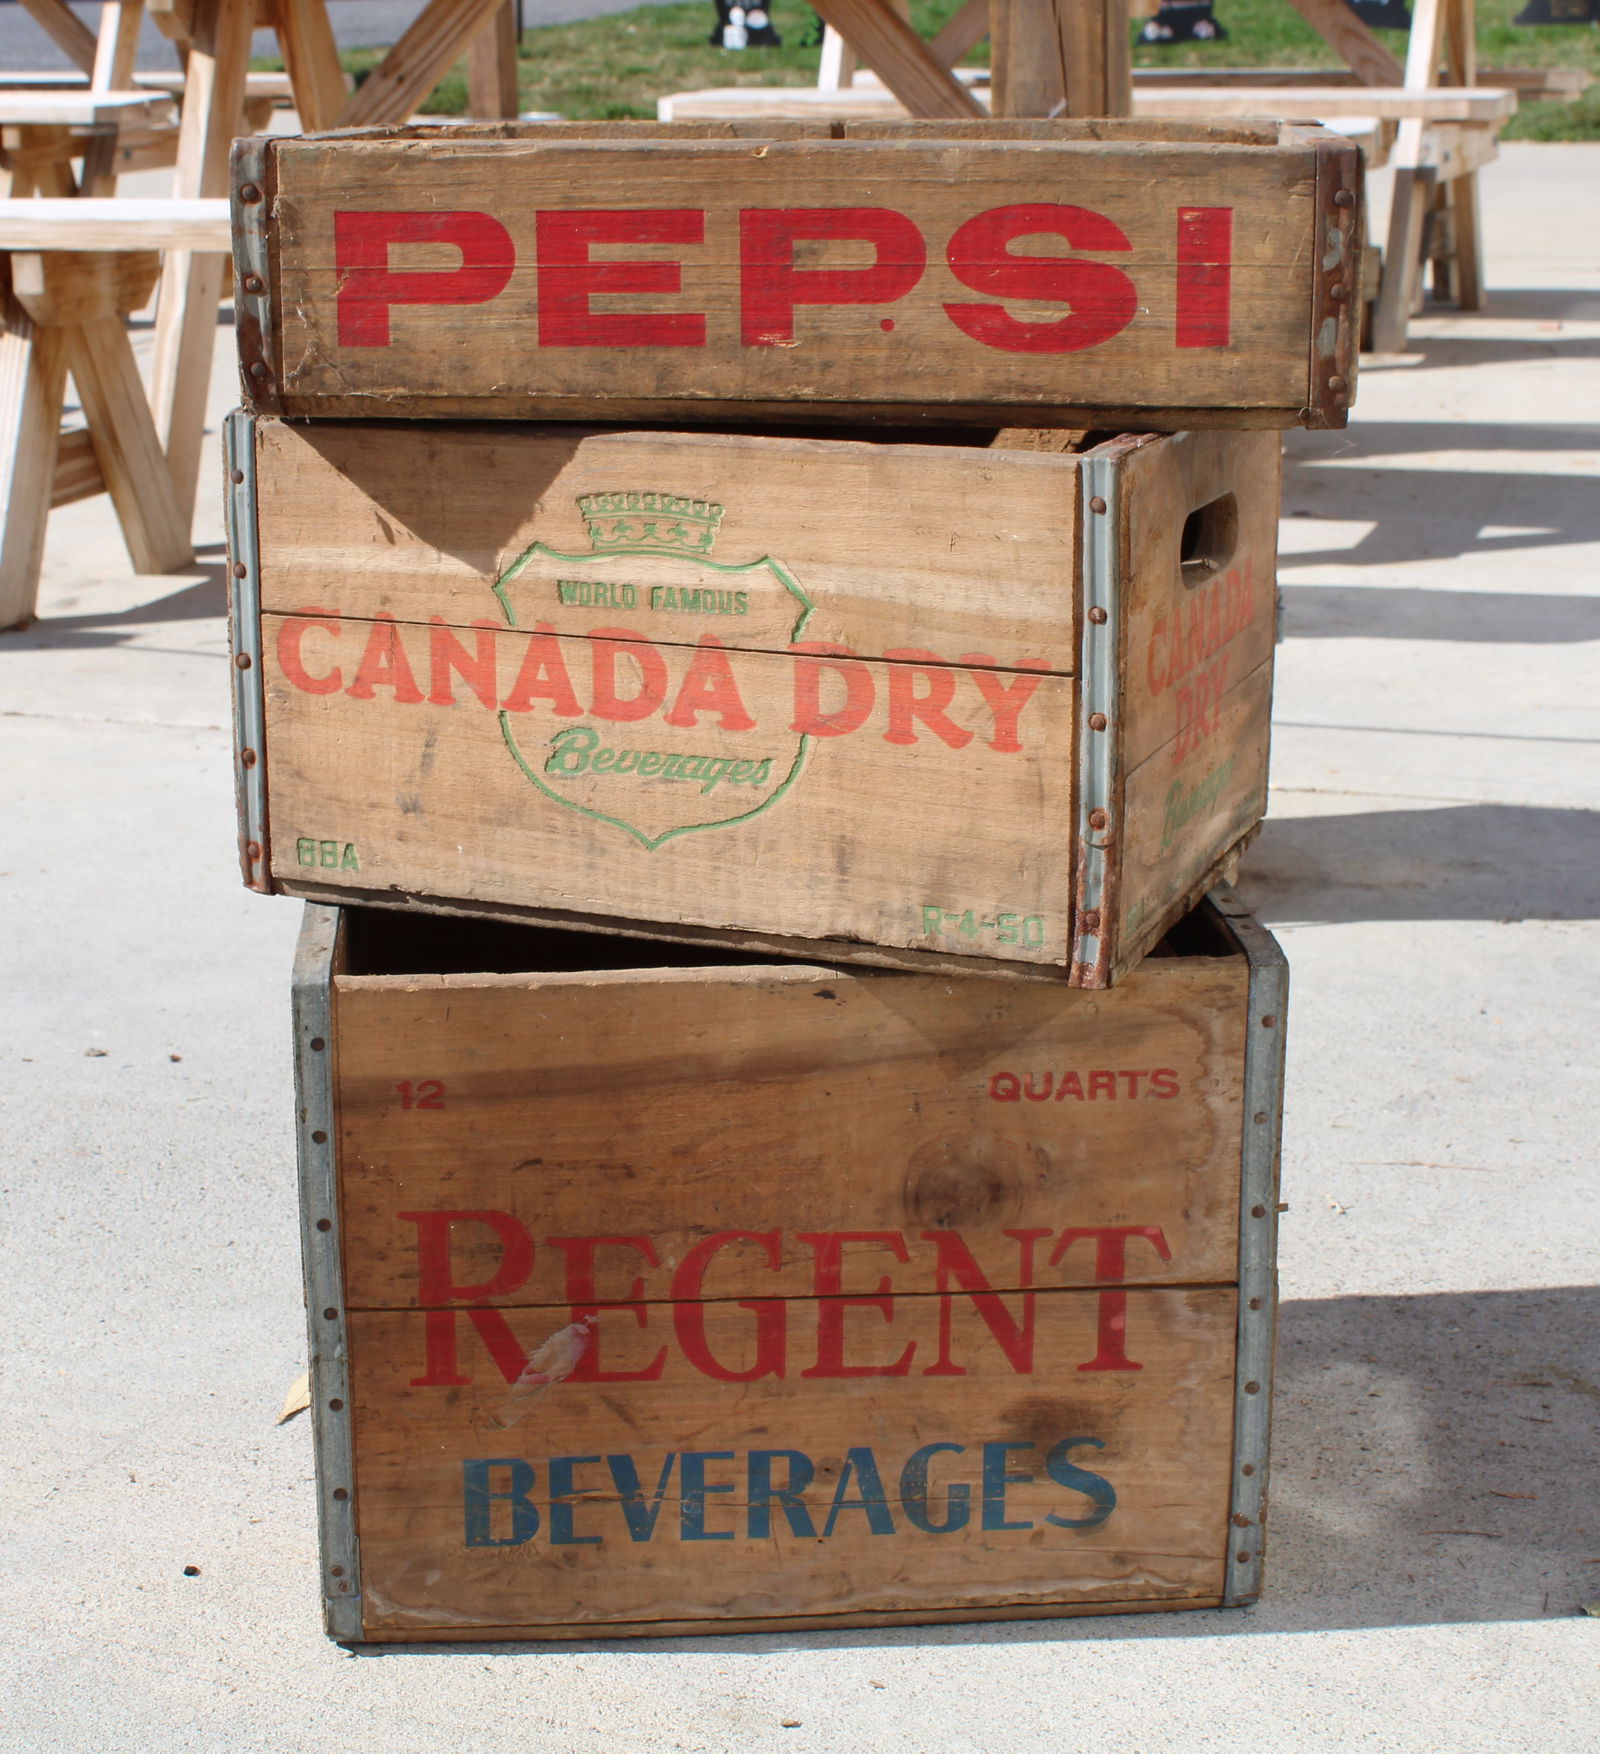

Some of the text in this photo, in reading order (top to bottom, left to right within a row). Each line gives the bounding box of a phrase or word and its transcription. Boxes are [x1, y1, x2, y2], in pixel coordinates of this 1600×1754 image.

[334, 203, 1233, 353] PEPSI
[557, 580, 751, 616] WORLD FAMOUS
[1147, 560, 1255, 696] CANADA
[277, 606, 1052, 753] CANADA DRY
[1171, 653, 1230, 766] DRY
[545, 728, 777, 796] Beverages
[397, 1068, 1180, 1110] 12 QUARTS
[398, 1210, 1172, 1387] REGENT
[463, 1436, 1117, 1548] BEVERAGES
